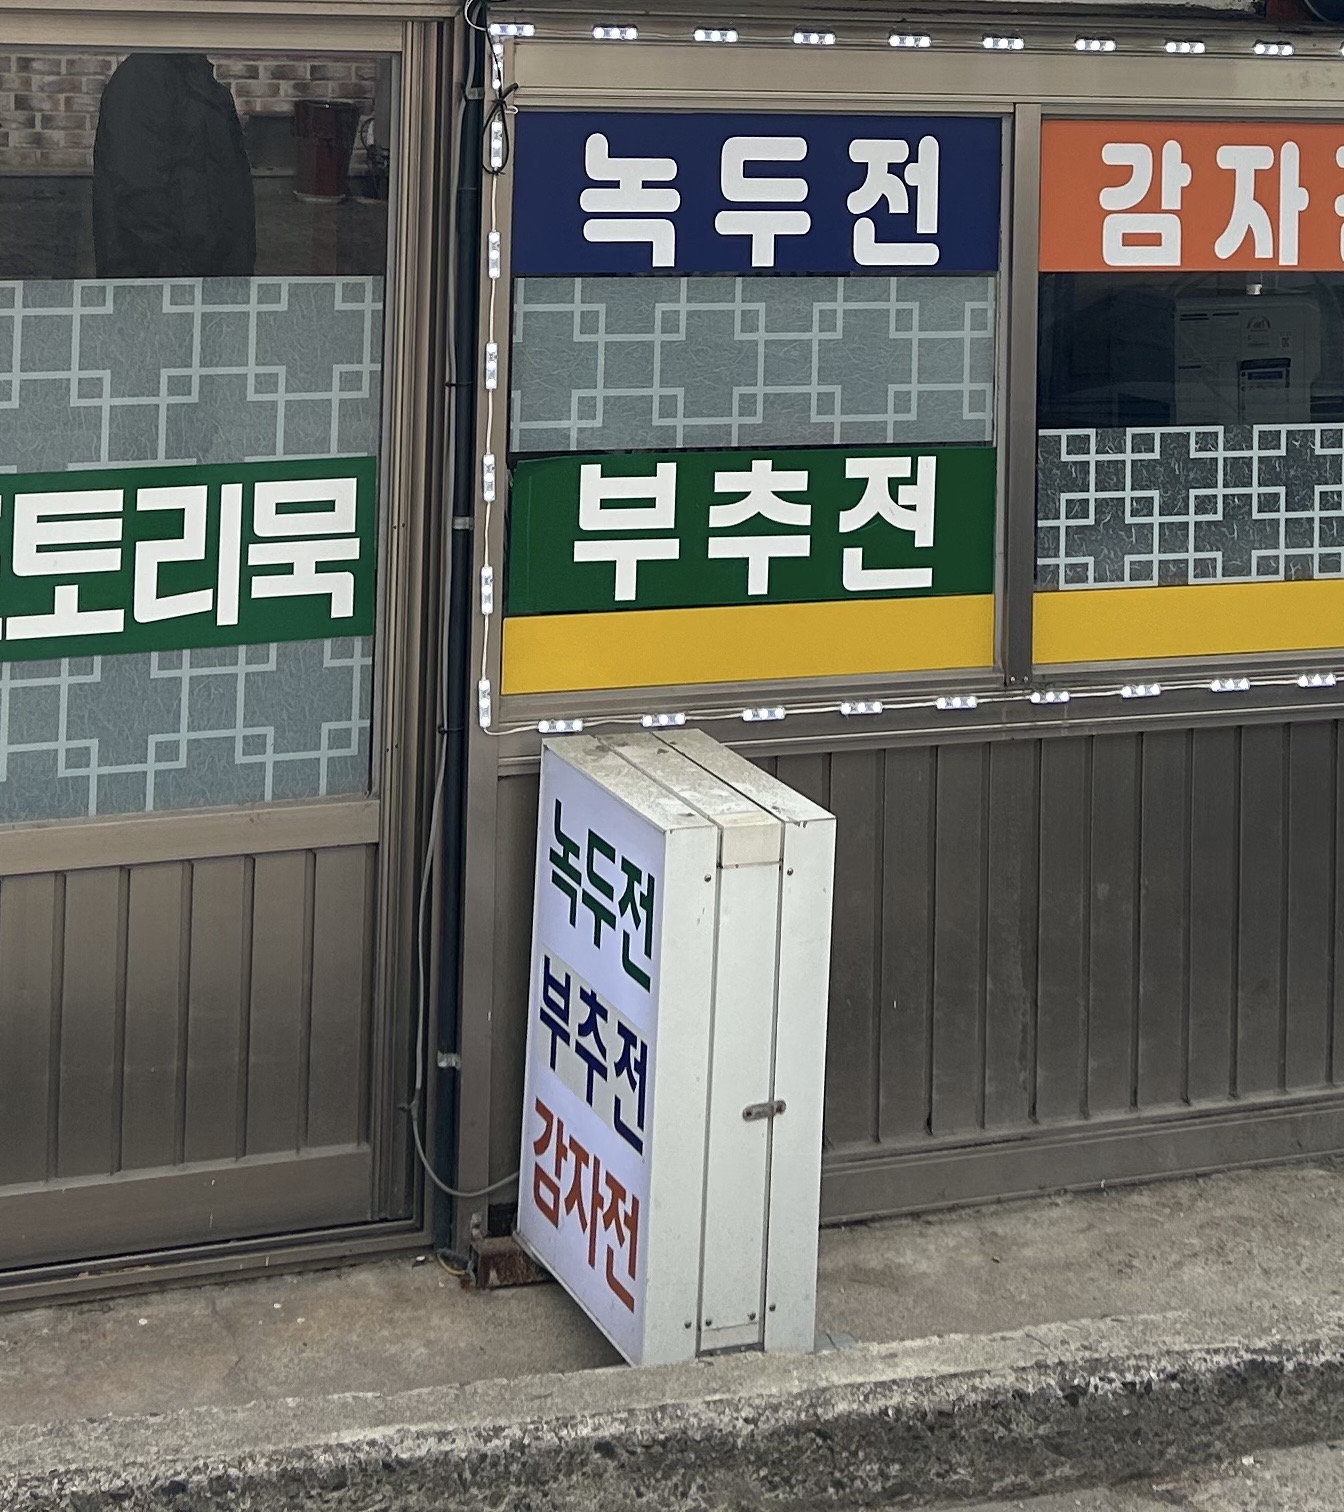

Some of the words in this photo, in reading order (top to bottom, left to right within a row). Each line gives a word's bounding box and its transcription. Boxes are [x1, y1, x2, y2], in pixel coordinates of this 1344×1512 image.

[578, 131, 941, 269] 녹두전
[572, 454, 938, 603] 부추전
[548, 798, 655, 993] 녹두전
[539, 954, 648, 1156] 부추전
[532, 1096, 640, 1313] 감자전
